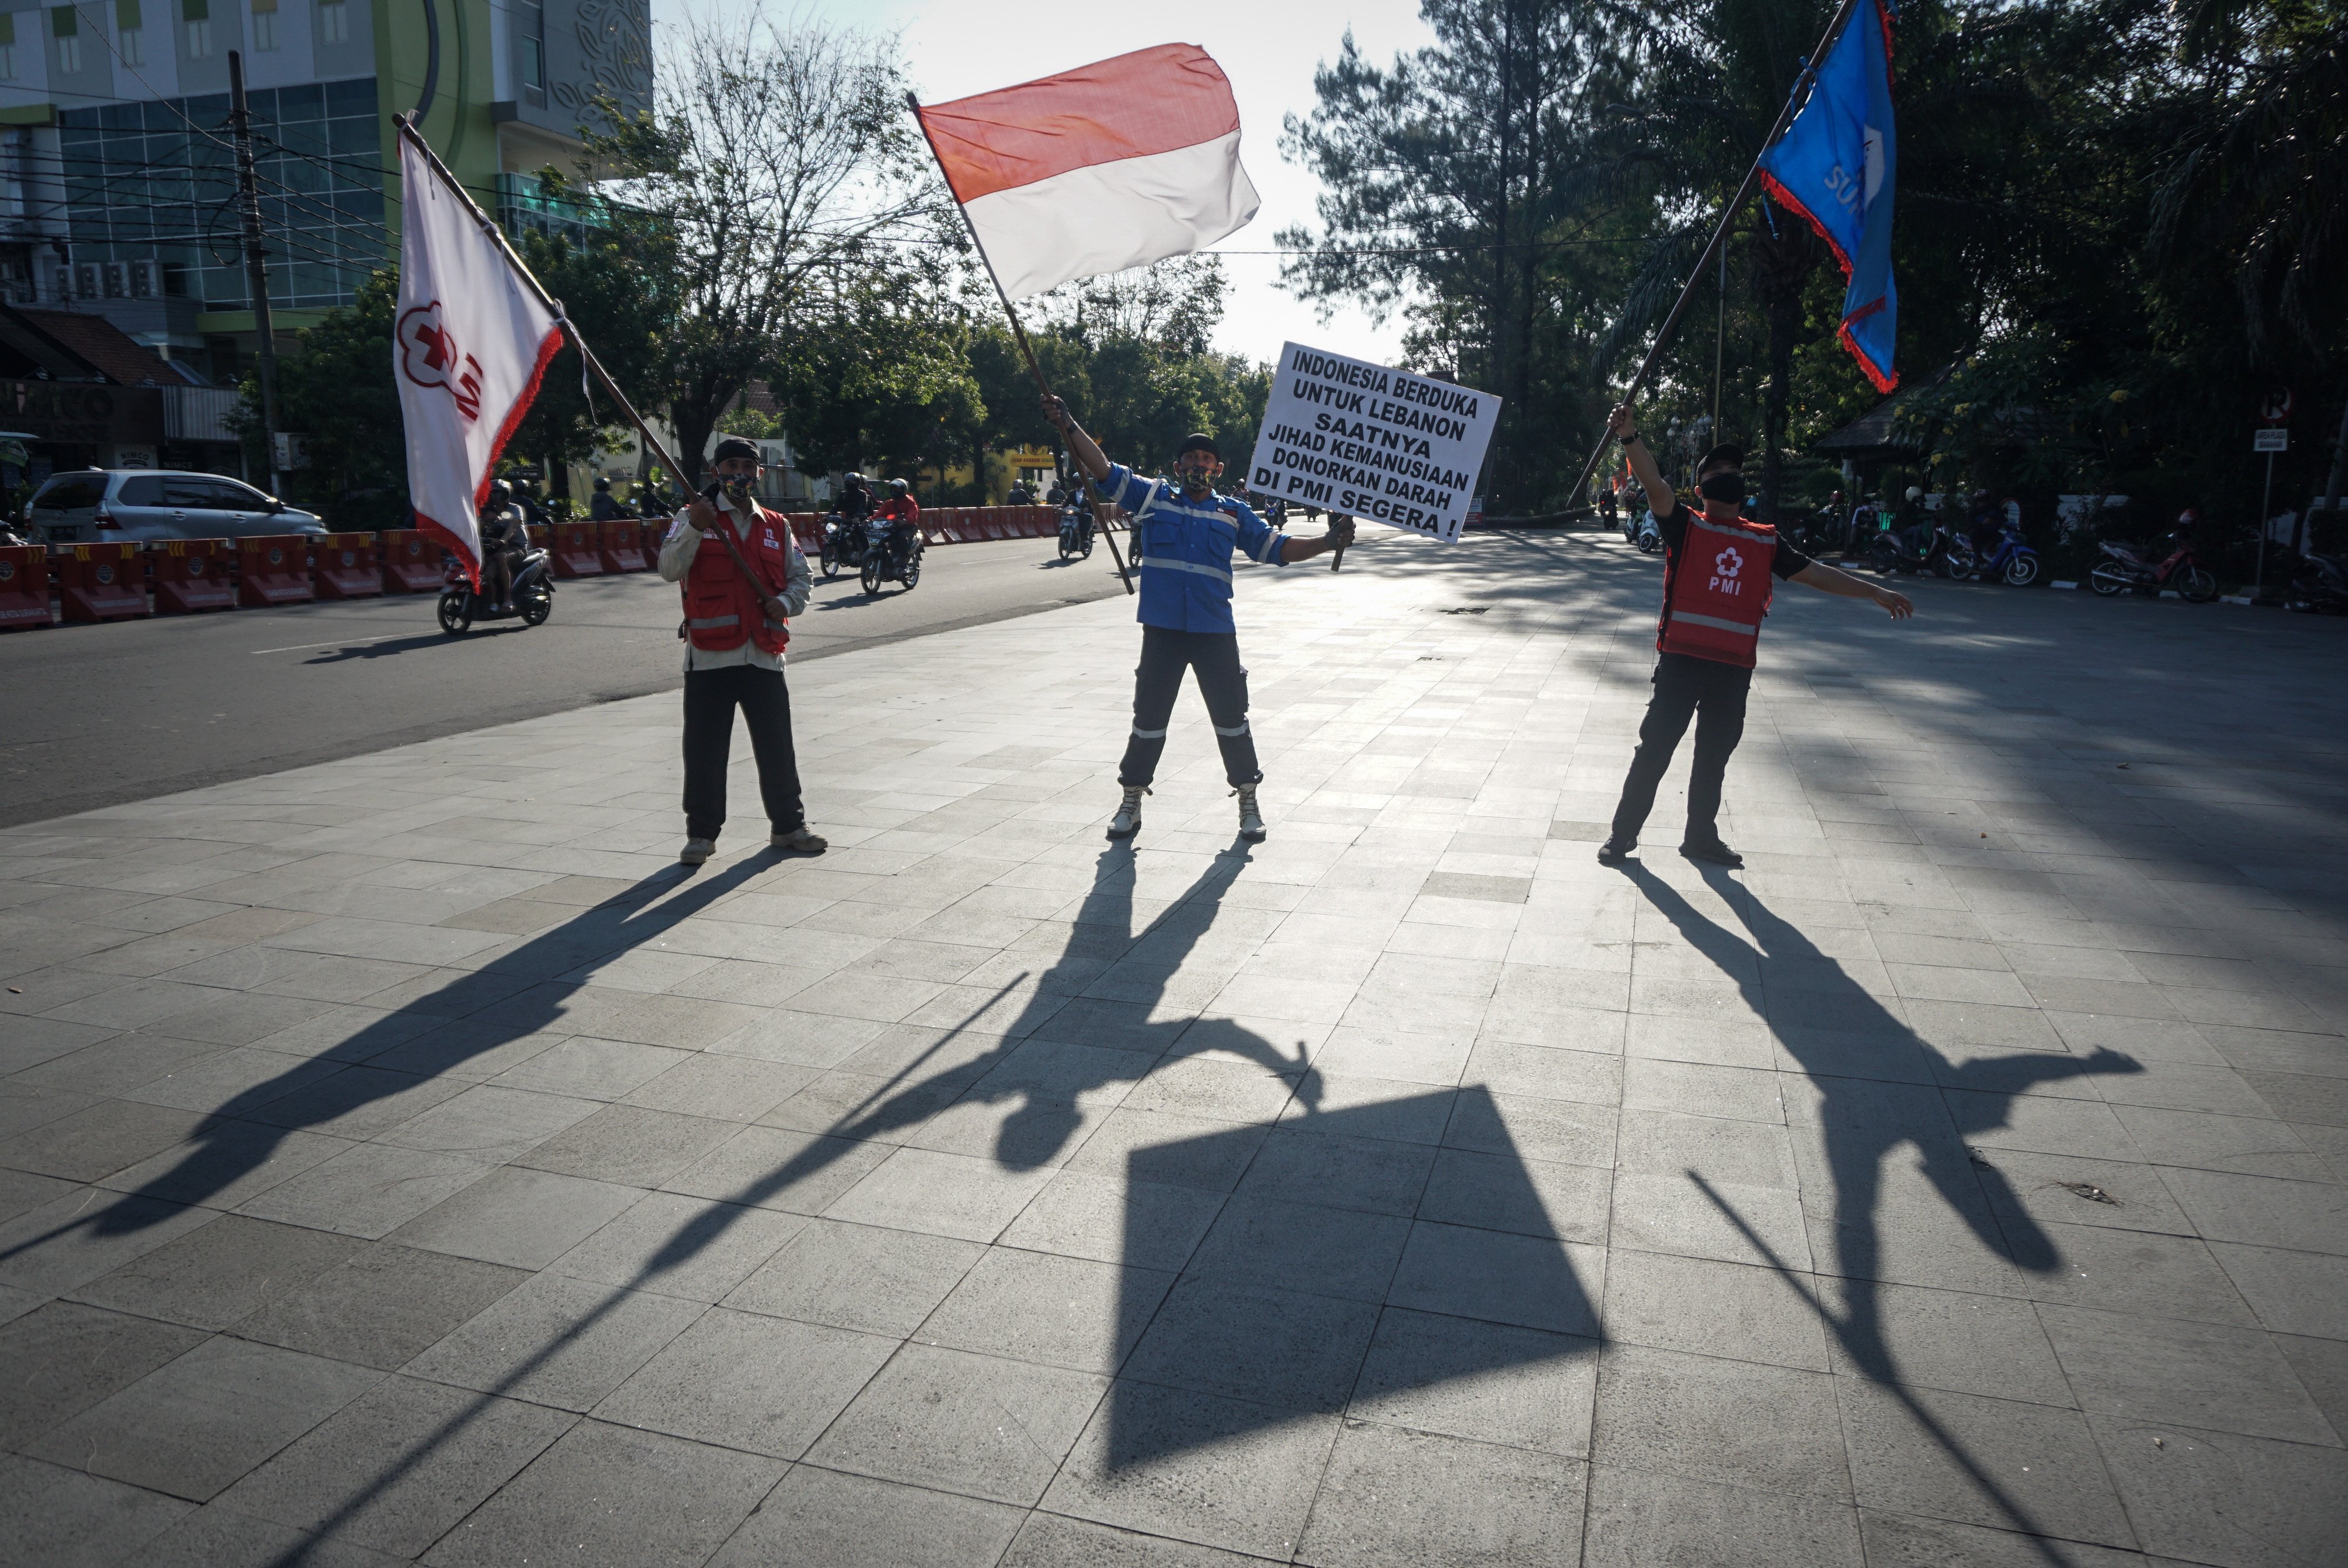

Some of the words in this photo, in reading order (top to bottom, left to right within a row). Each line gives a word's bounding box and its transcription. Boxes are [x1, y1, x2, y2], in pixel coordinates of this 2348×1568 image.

[1292, 350, 1388, 395] INDONESIA
[1392, 377, 1478, 419] BERDUKA
[1293, 378, 1366, 414] UNTUK
[1368, 398, 1467, 442] LEBANON
[1268, 423, 1326, 452] JIHAD
[1330, 438, 1469, 492] KEMANUSIAAN
[1314, 413, 1431, 459] SAATNYA
[1254, 467, 1281, 490] DI
[1287, 476, 1334, 503] PMI
[1339, 490, 1438, 534] SEGERA
[1272, 447, 1382, 491] DONORKAN
[1384, 477, 1452, 510] DARAH
[1708, 576, 1741, 596] PMI
